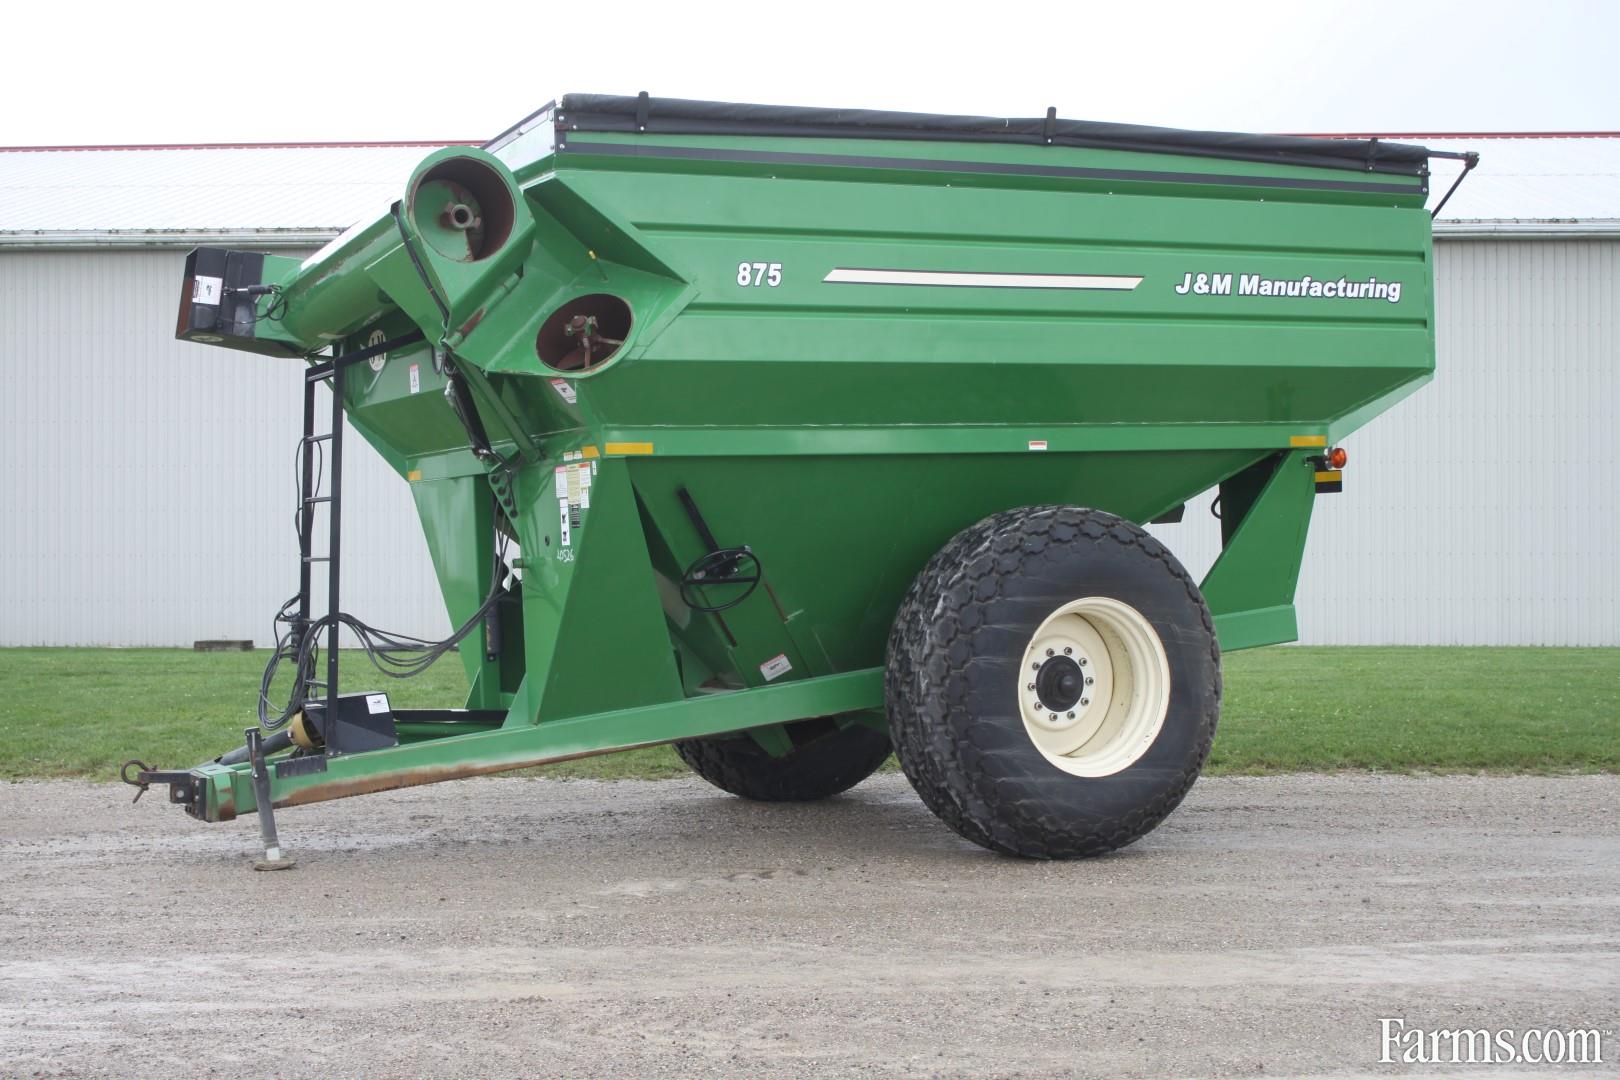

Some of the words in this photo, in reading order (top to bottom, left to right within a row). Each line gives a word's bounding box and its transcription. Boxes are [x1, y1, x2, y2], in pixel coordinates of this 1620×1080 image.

[737, 262, 782, 287] 875
[1175, 273, 1232, 295] J&M
[1238, 274, 1401, 302] Manufacturing
